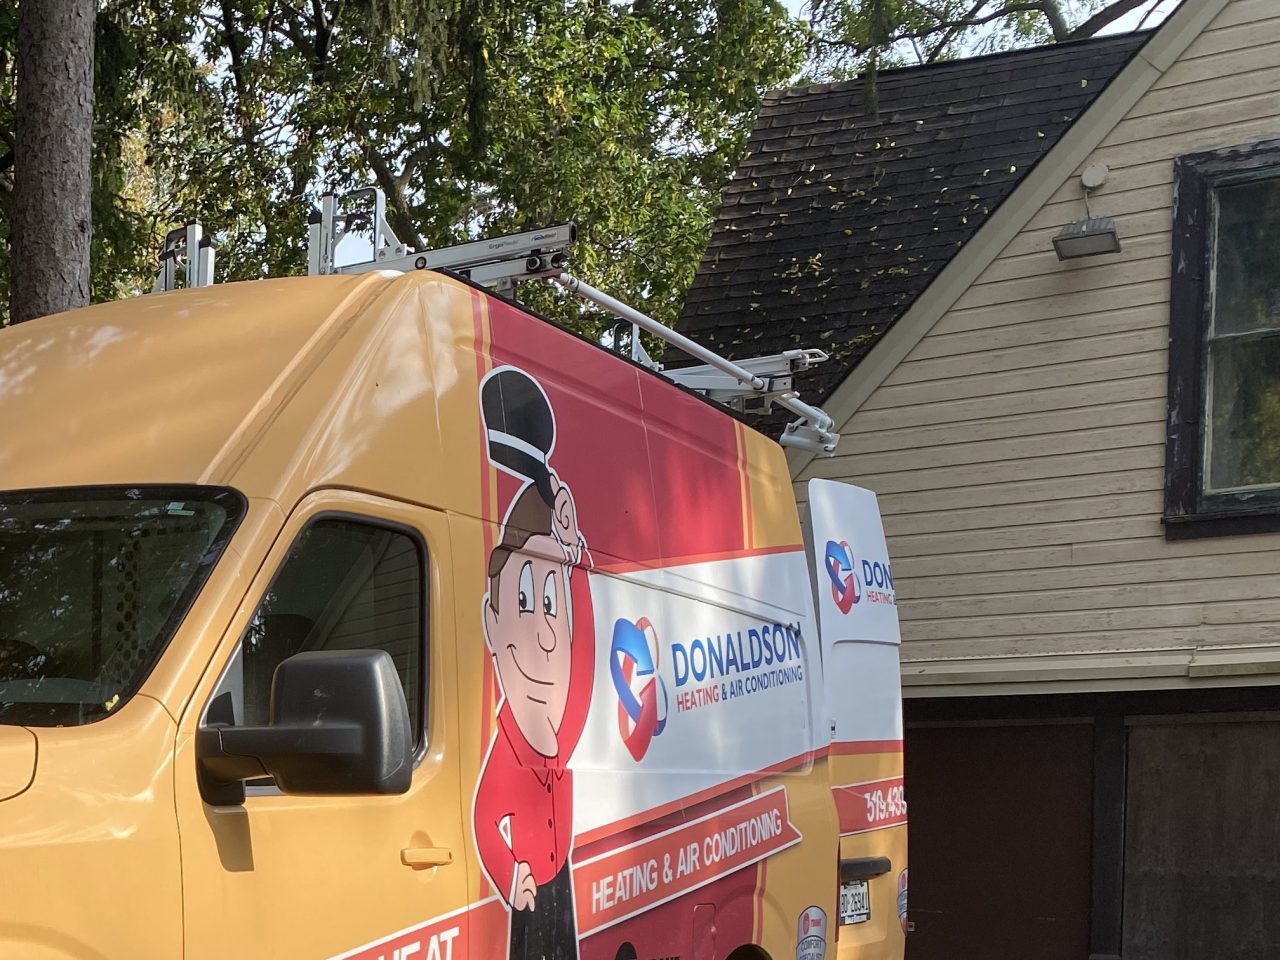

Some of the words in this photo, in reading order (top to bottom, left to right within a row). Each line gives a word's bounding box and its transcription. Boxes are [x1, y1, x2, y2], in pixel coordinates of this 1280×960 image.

[671, 621, 801, 687] DONALDSON
[676, 684, 720, 713] HEATING
[721, 682, 728, 701] &
[729, 678, 744, 699] AIR
[745, 665, 803, 695] CONDITIONING
[592, 861, 658, 914] HEATING
[662, 853, 673, 884] &
[676, 841, 700, 879] AIR
[703, 808, 783, 866] CONDITIONING
[851, 891, 868, 913] 26941
